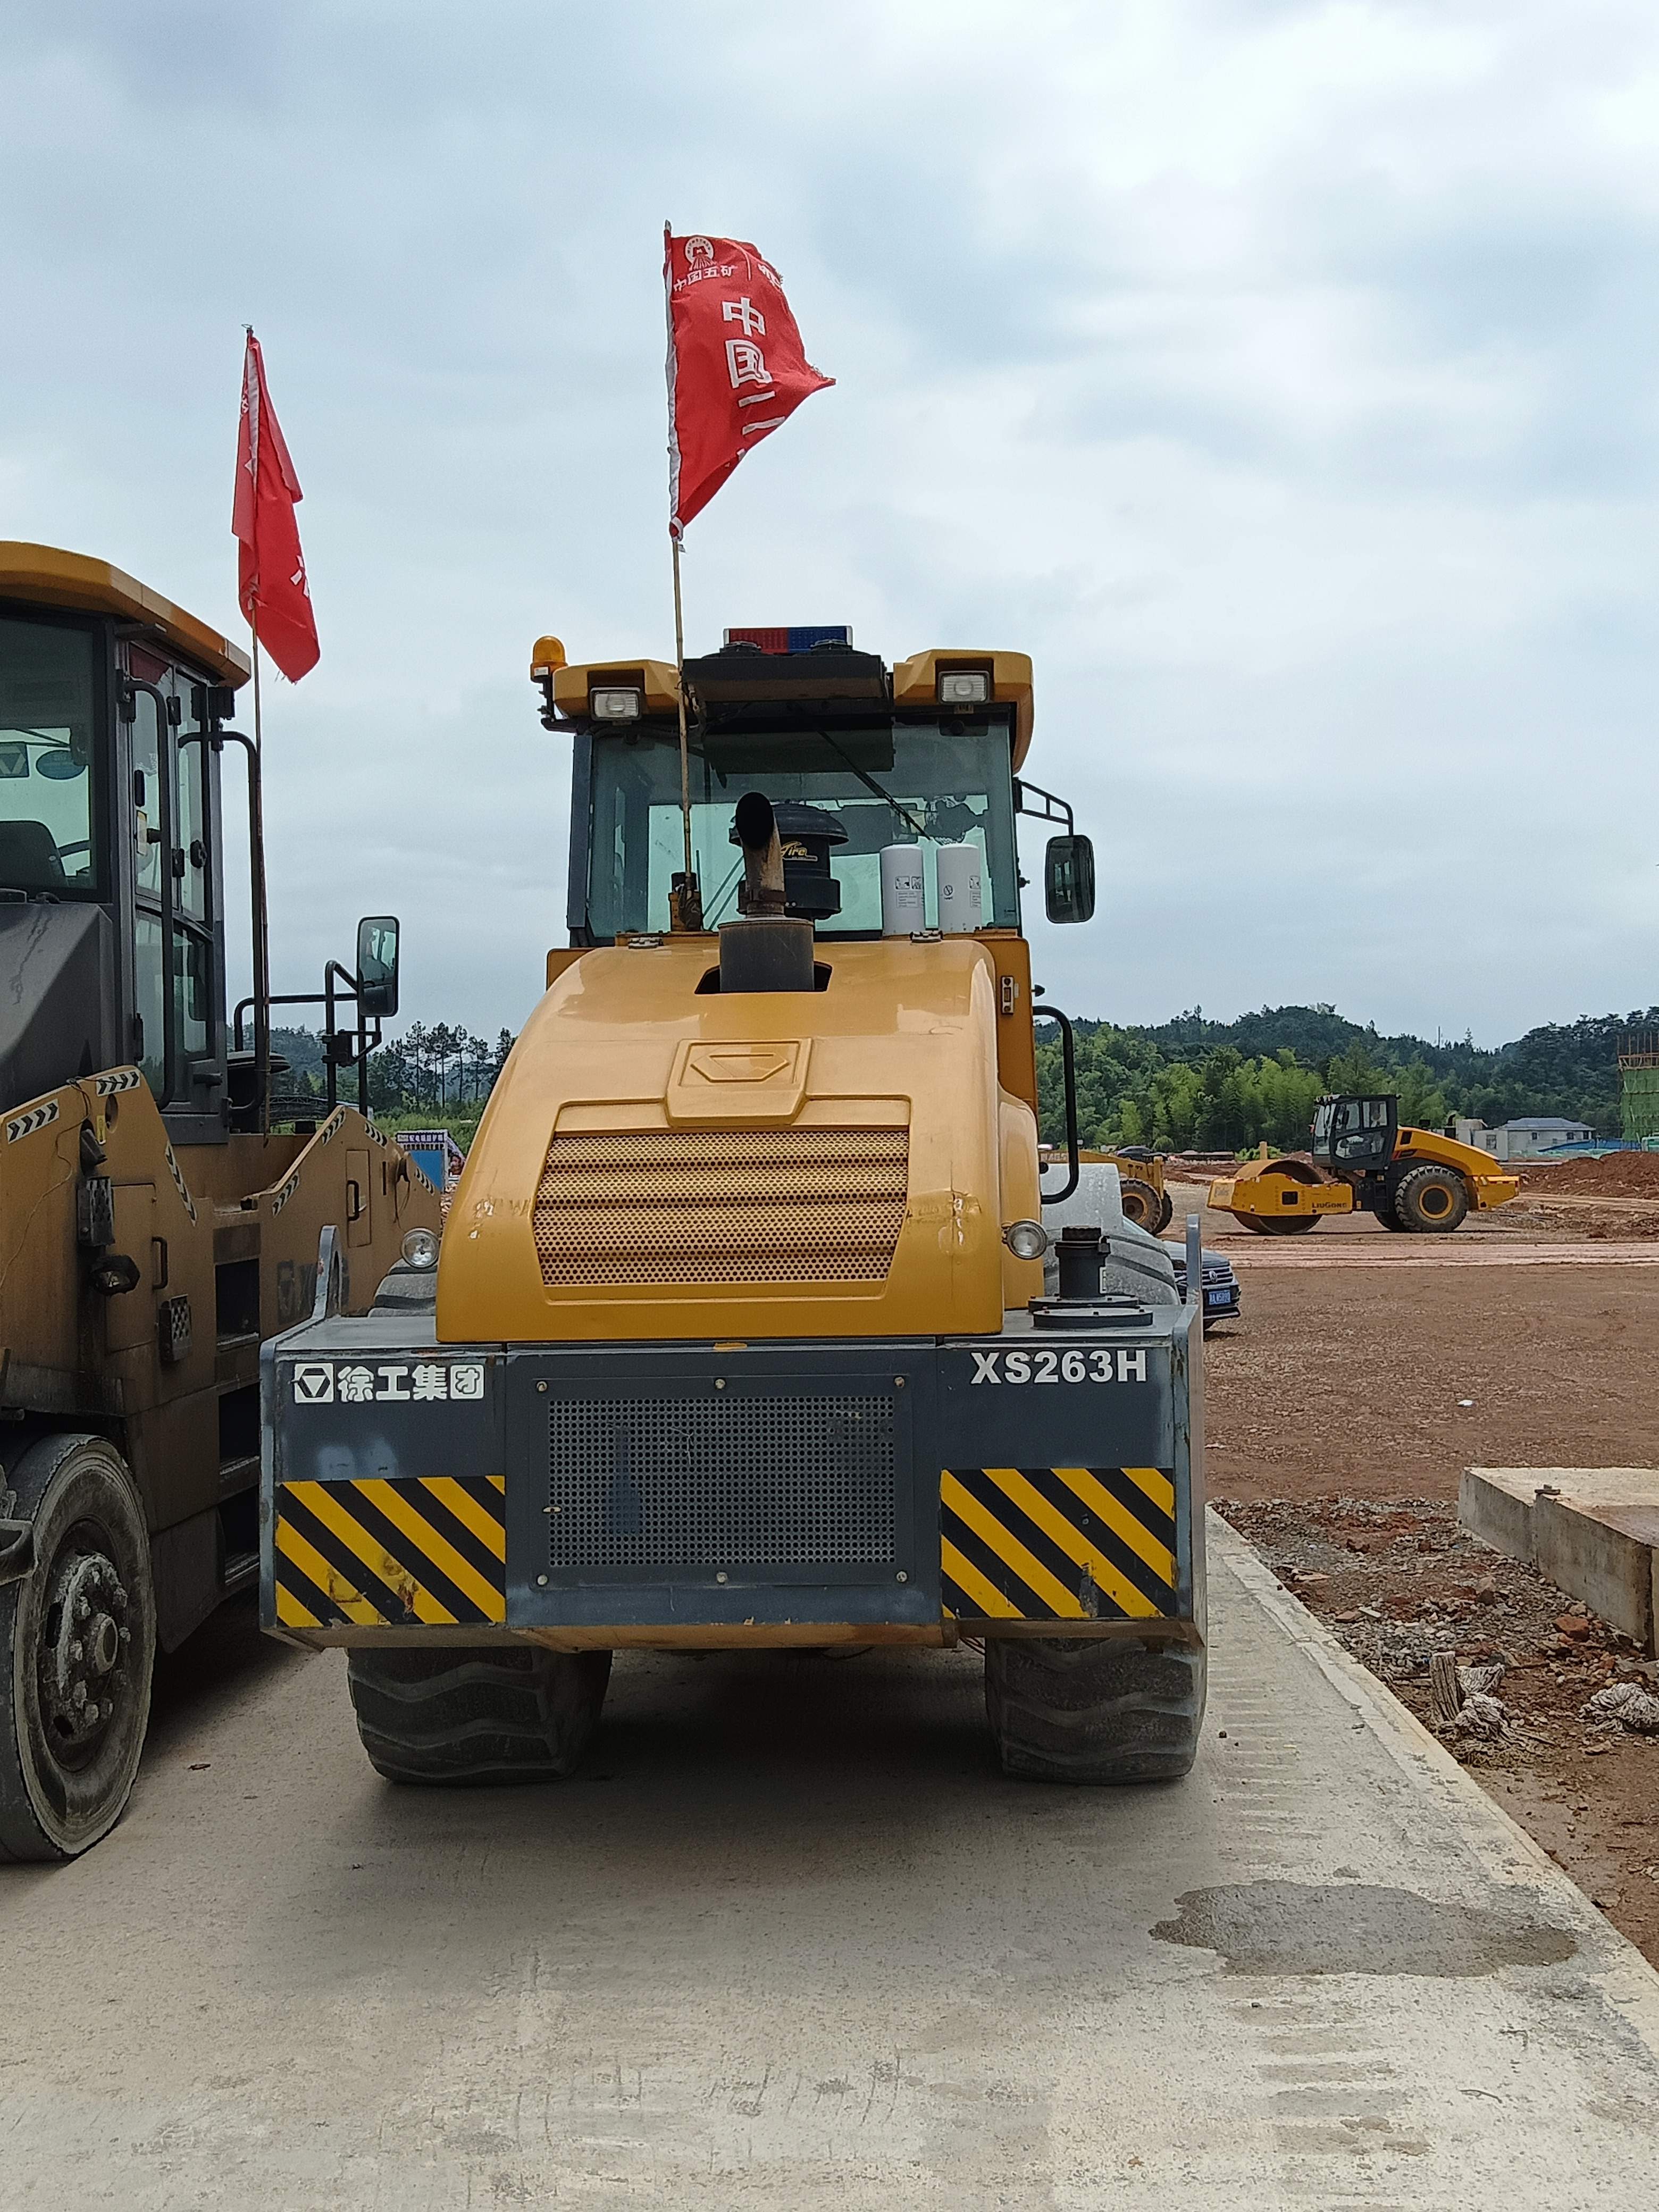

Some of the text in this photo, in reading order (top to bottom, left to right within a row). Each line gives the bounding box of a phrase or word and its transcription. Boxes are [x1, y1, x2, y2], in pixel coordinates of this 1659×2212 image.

[673, 265, 738, 292] 中国五矿
[722, 297, 785, 460] 中国二
[338, 1364, 484, 1403] 徐工集团
[970, 1350, 1146, 1384] XS263H
